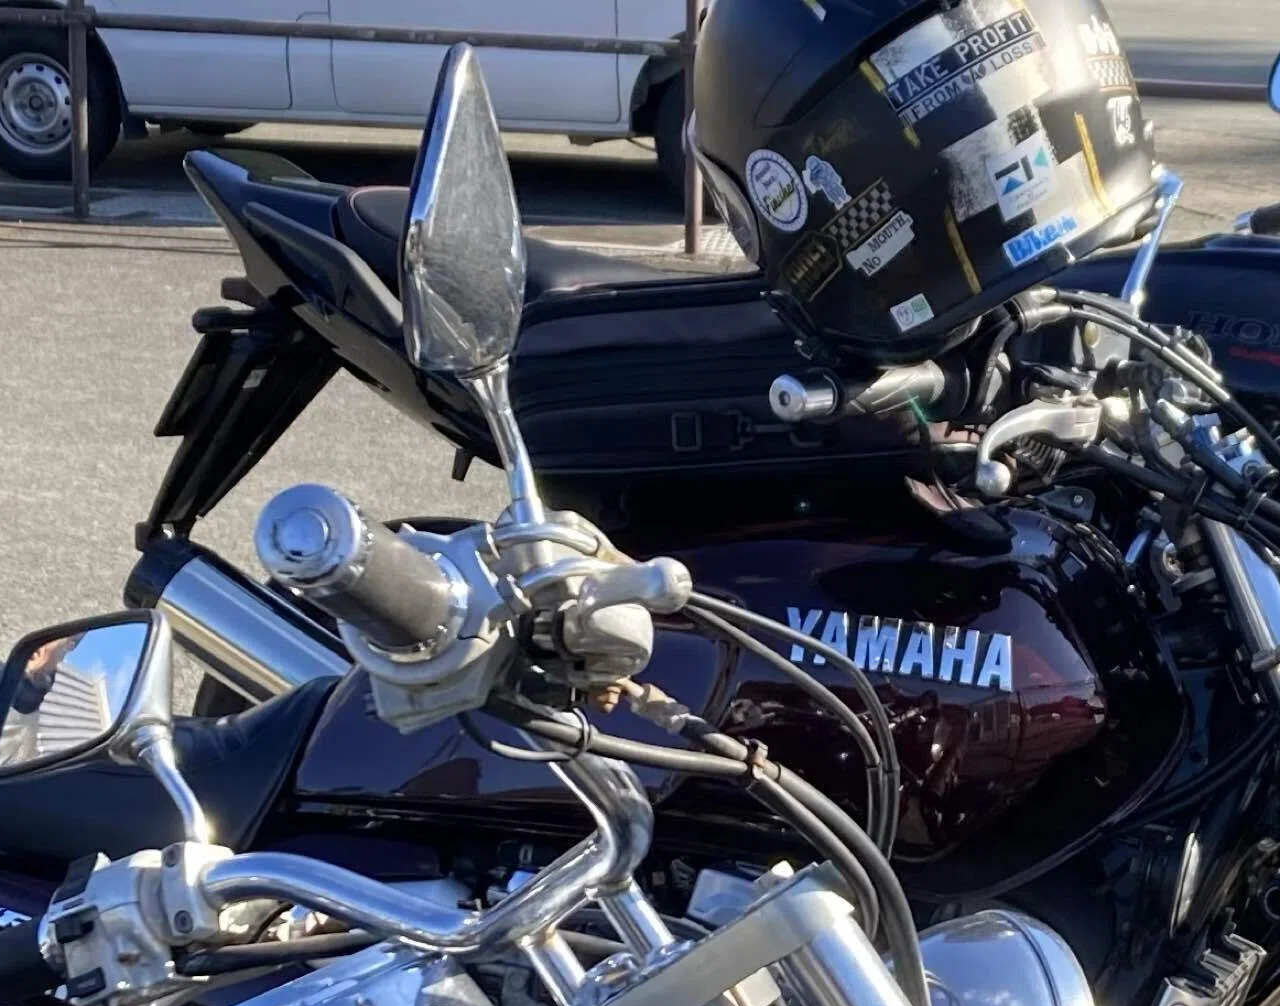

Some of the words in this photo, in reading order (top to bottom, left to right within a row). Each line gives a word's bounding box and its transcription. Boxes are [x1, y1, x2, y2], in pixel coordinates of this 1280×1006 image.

[888, 57, 949, 103] TAKE
[955, 12, 1030, 63] PROFIT
[911, 82, 961, 119] FROM
[991, 41, 1033, 68] LOSS
[868, 212, 908, 252] MOUTH
[786, 606, 1014, 693] YAMAHA
